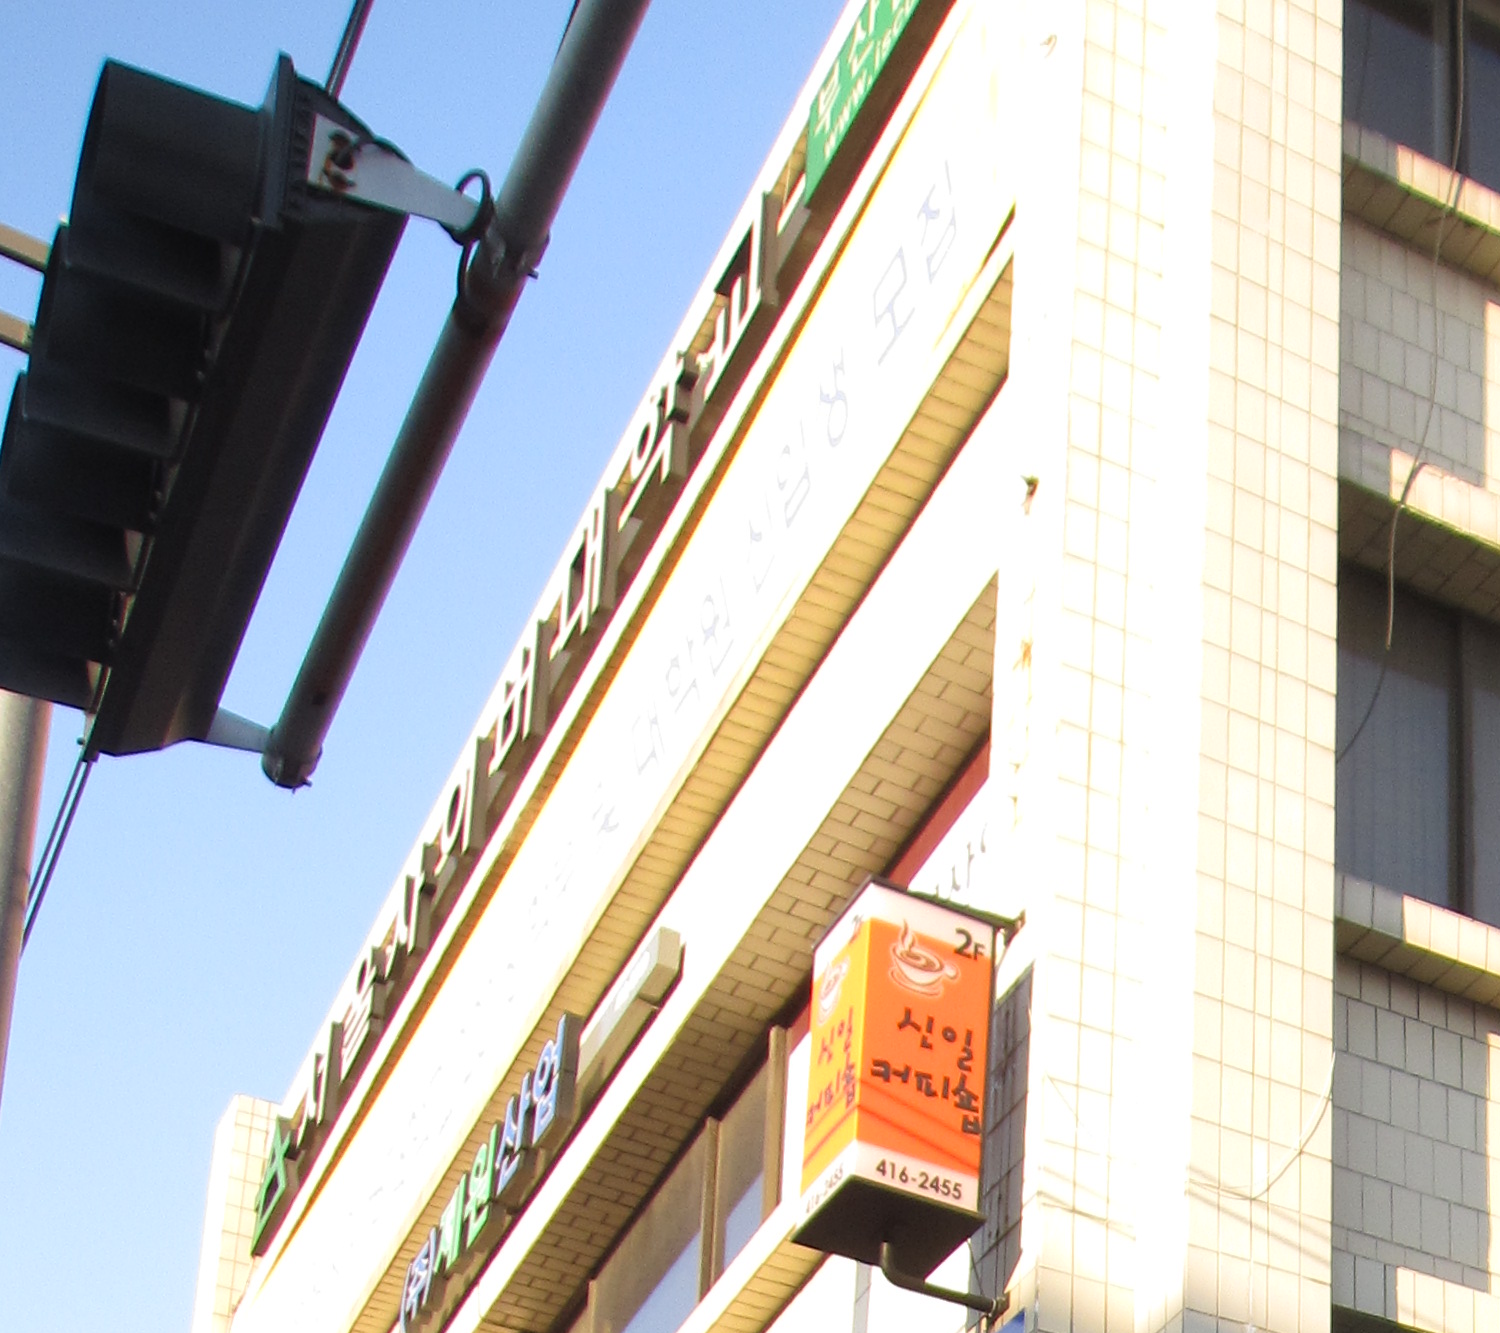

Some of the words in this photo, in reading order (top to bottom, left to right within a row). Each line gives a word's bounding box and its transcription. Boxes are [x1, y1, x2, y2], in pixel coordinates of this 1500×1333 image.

[870, 158, 958, 366] 모집
[953, 926, 986, 964] 2F
[896, 1006, 974, 1074] 신일
[870, 1057, 982, 1137] 커피숍
[876, 1158, 963, 1202] 416-2455
